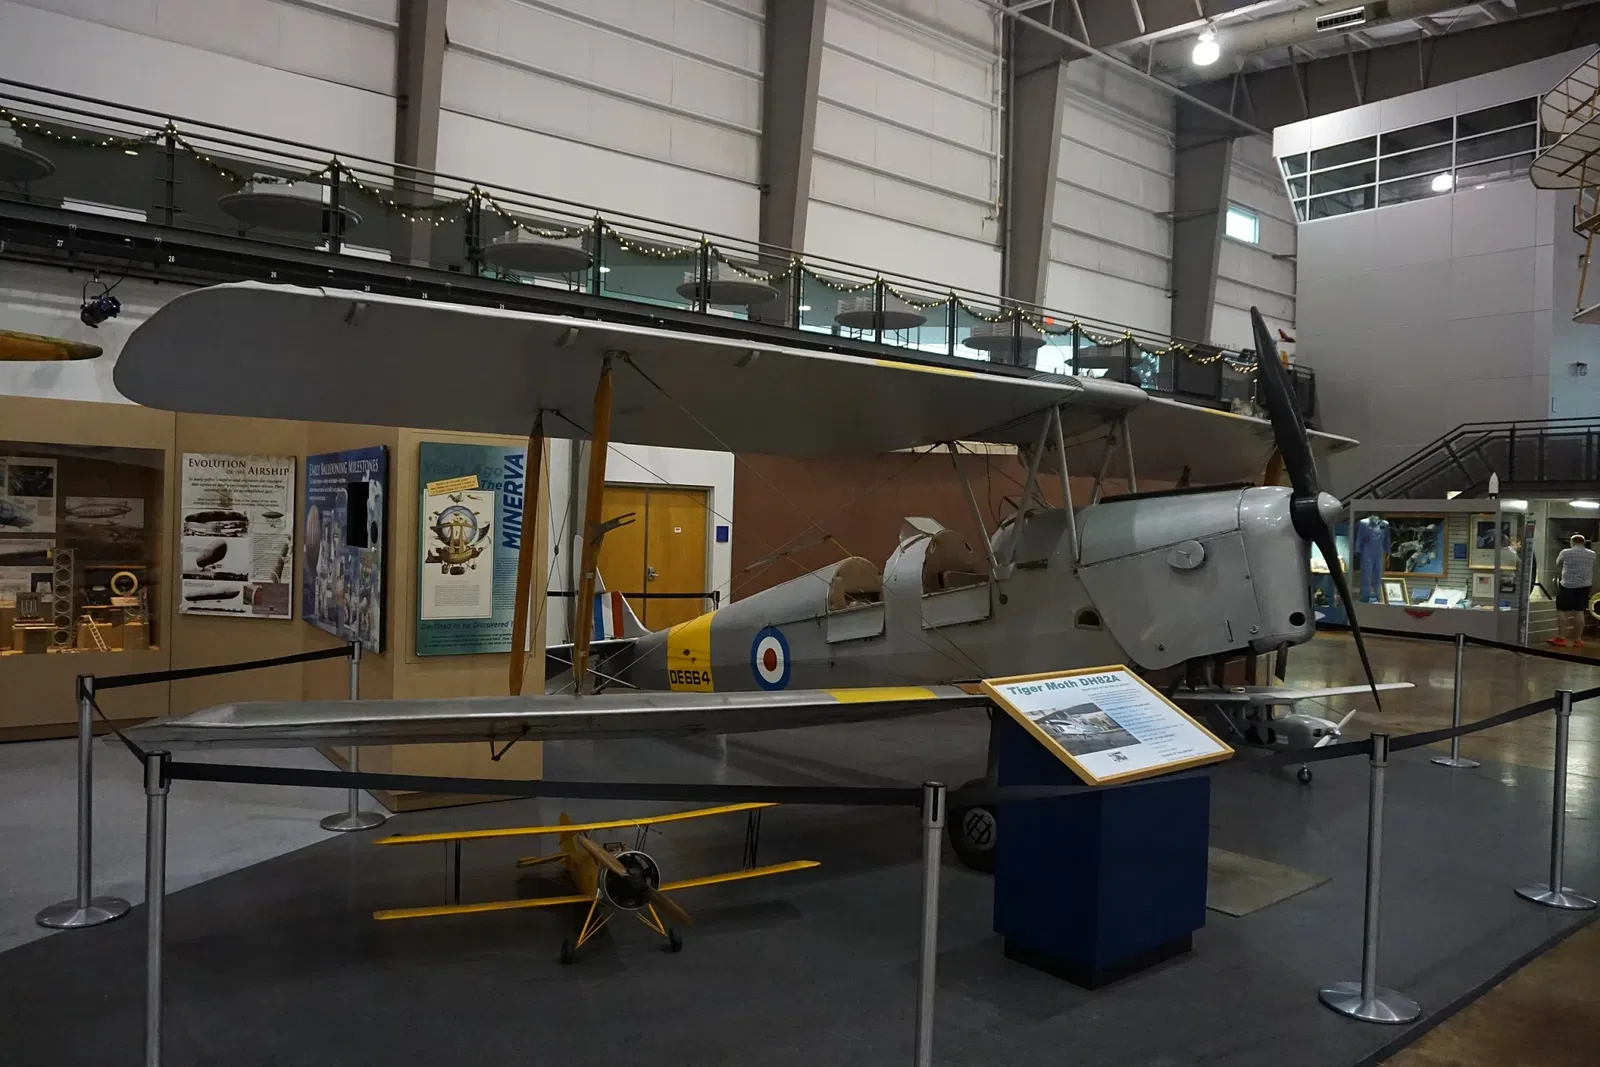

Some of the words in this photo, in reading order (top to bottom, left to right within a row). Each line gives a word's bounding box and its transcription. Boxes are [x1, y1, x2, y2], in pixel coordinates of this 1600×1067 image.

[188, 458, 246, 468] EVOLUTION
[348, 458, 379, 473] MILESTONES
[248, 467, 290, 476] AIRSHIP
[480, 479, 502, 490] The
[502, 454, 524, 549] MINERVA
[473, 620, 509, 629] Discovered
[670, 671, 711, 685] DE664
[1006, 685, 1043, 696] Tiger
[1047, 679, 1078, 691] Moth
[1079, 674, 1121, 687] DH82A
